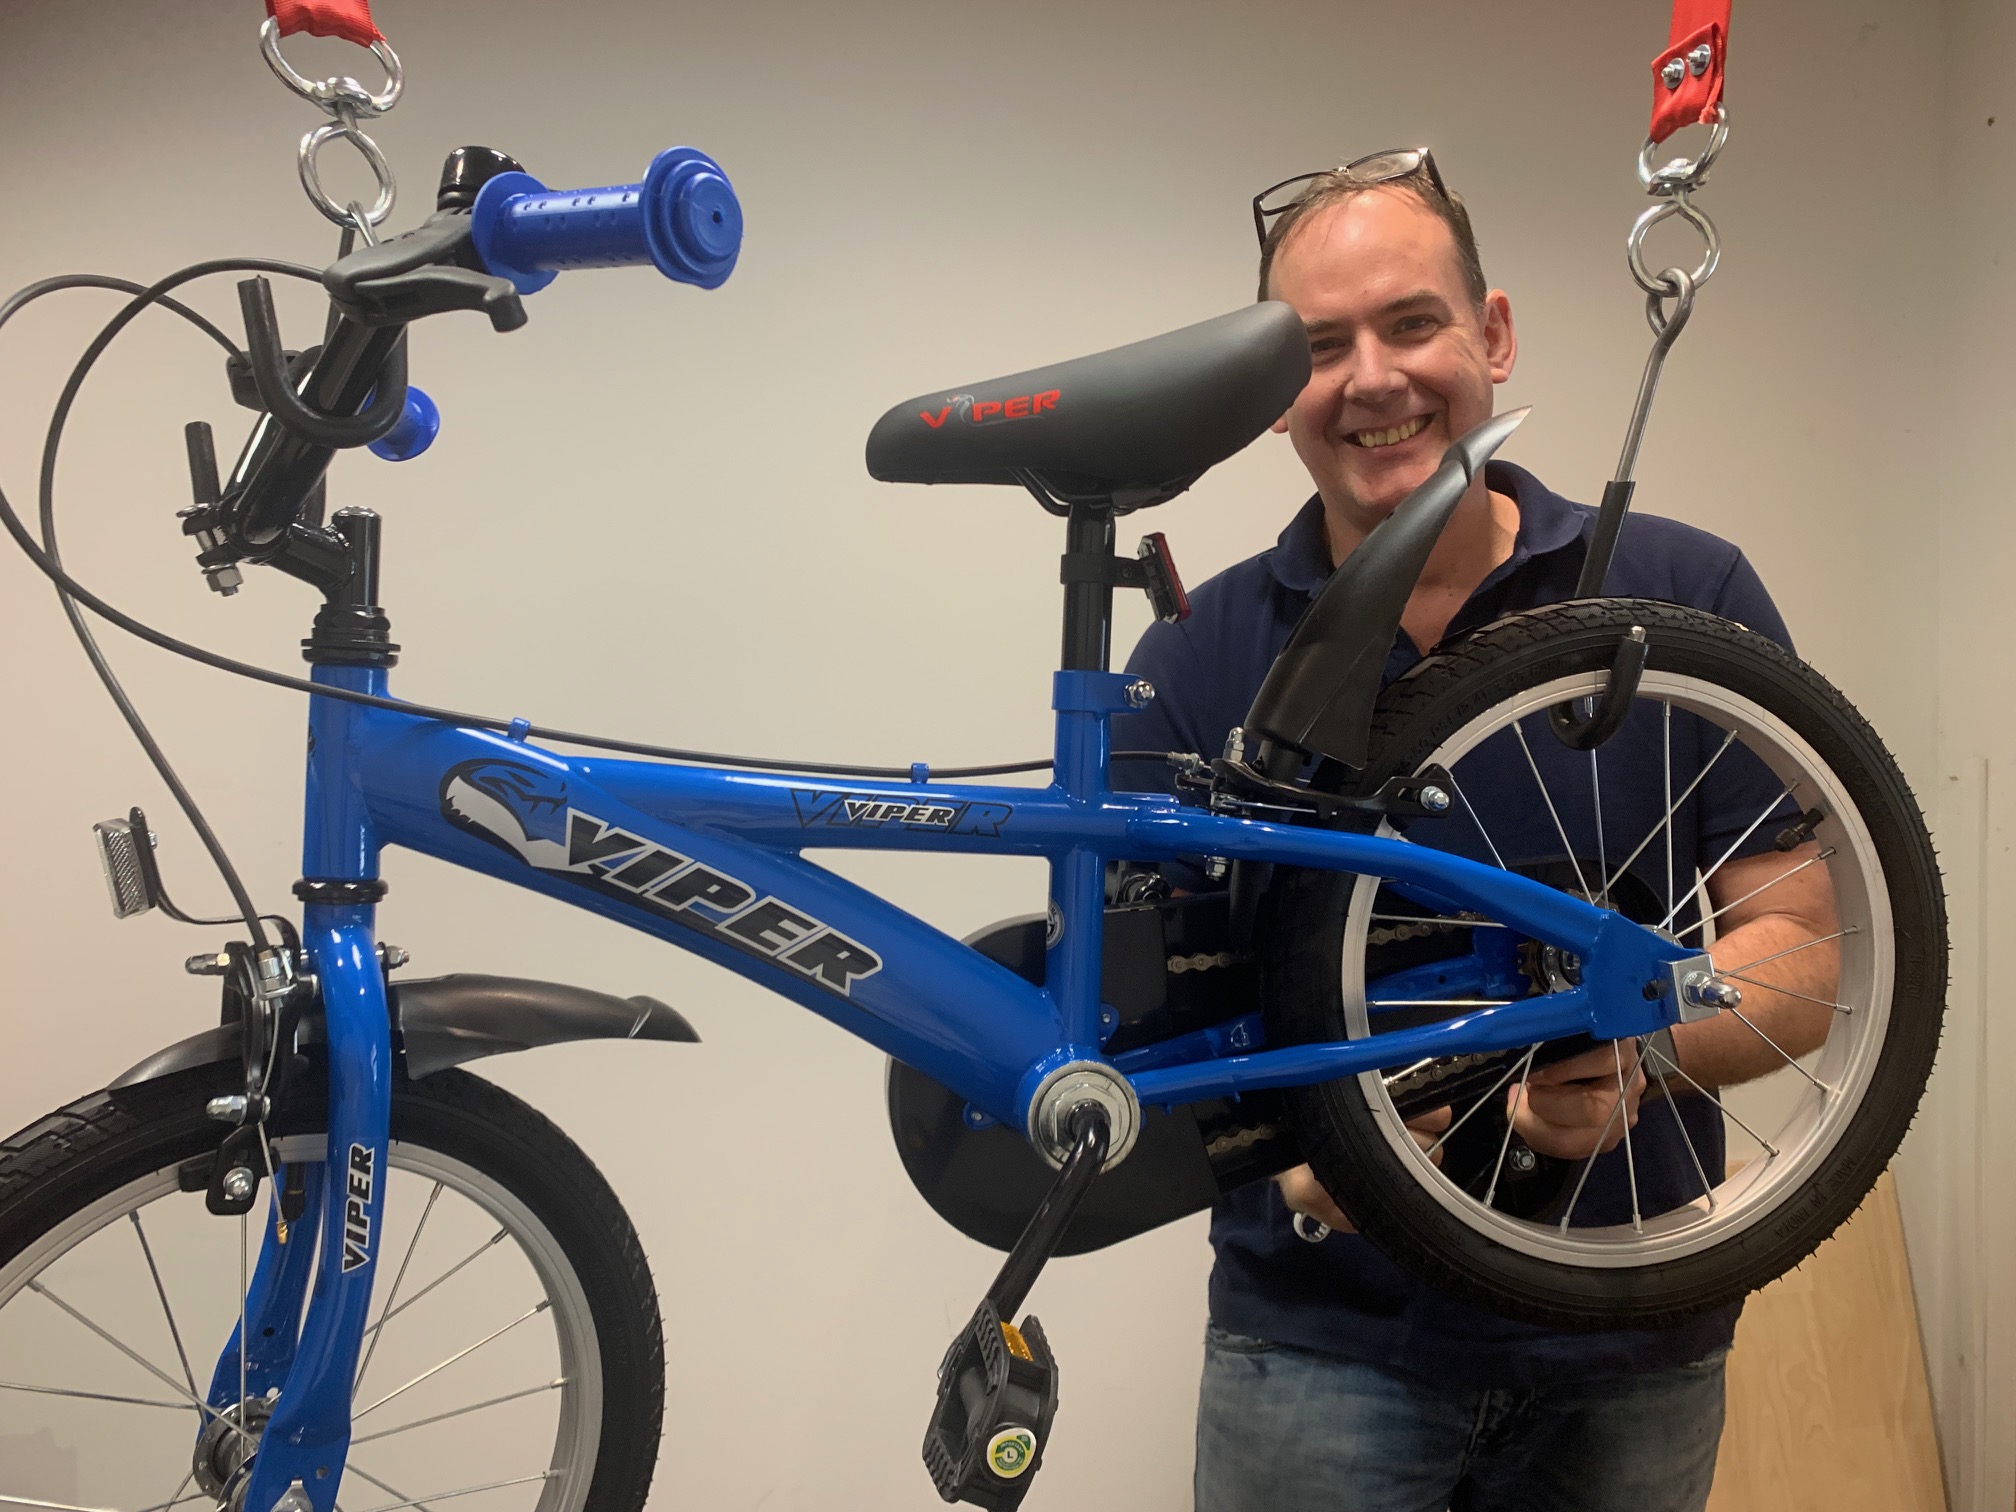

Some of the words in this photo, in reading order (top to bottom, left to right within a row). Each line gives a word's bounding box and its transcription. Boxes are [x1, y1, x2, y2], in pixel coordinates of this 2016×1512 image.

[844, 799, 955, 826] VIPER
[566, 807, 883, 997] VIPER
[342, 1142, 375, 1273] VIPER
[1007, 1450, 1013, 1458] L
